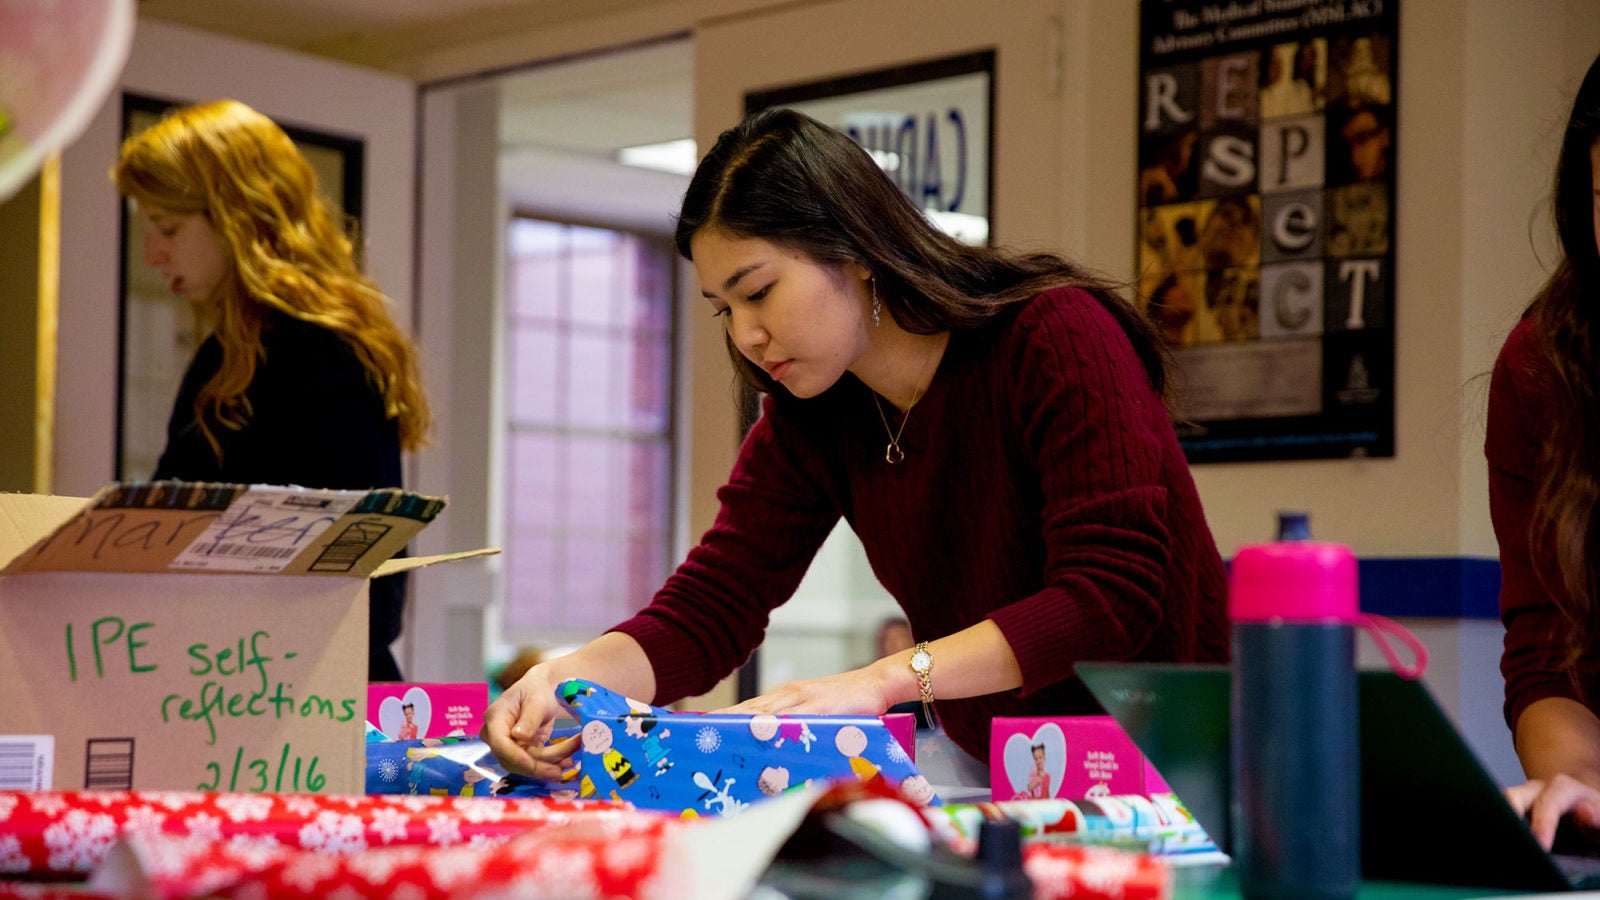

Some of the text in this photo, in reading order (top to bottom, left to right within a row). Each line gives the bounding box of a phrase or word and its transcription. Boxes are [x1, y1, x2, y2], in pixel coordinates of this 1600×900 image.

[1153, 32, 1214, 55] Advisory
[1215, 18, 1299, 43] Committee
[1173, 9, 1200, 31] The
[1201, 1, 1261, 24] Medical
[1144, 57, 1248, 131] R E
[1273, 203, 1316, 250] e
[1338, 259, 1381, 331] T
[66, 616, 159, 682] IPE
[161, 681, 357, 746] reflections
[196, 742, 327, 792] 2/3/16
